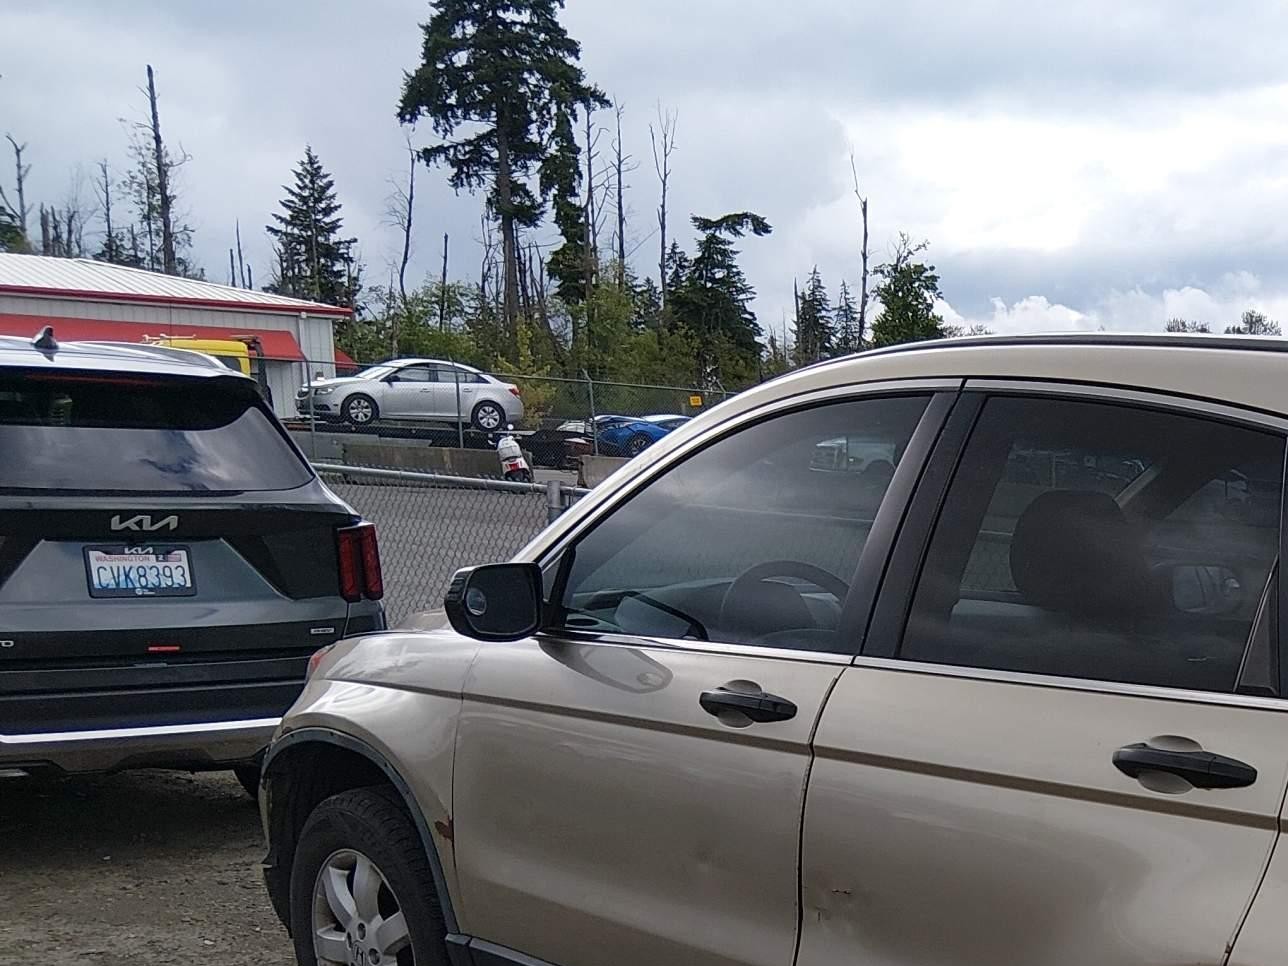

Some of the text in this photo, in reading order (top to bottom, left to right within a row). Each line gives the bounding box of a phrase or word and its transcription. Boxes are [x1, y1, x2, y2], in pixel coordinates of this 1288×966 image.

[111, 515, 179, 531] KIA
[96, 555, 151, 563] WASHINGTON
[97, 565, 187, 589] CVK8393
